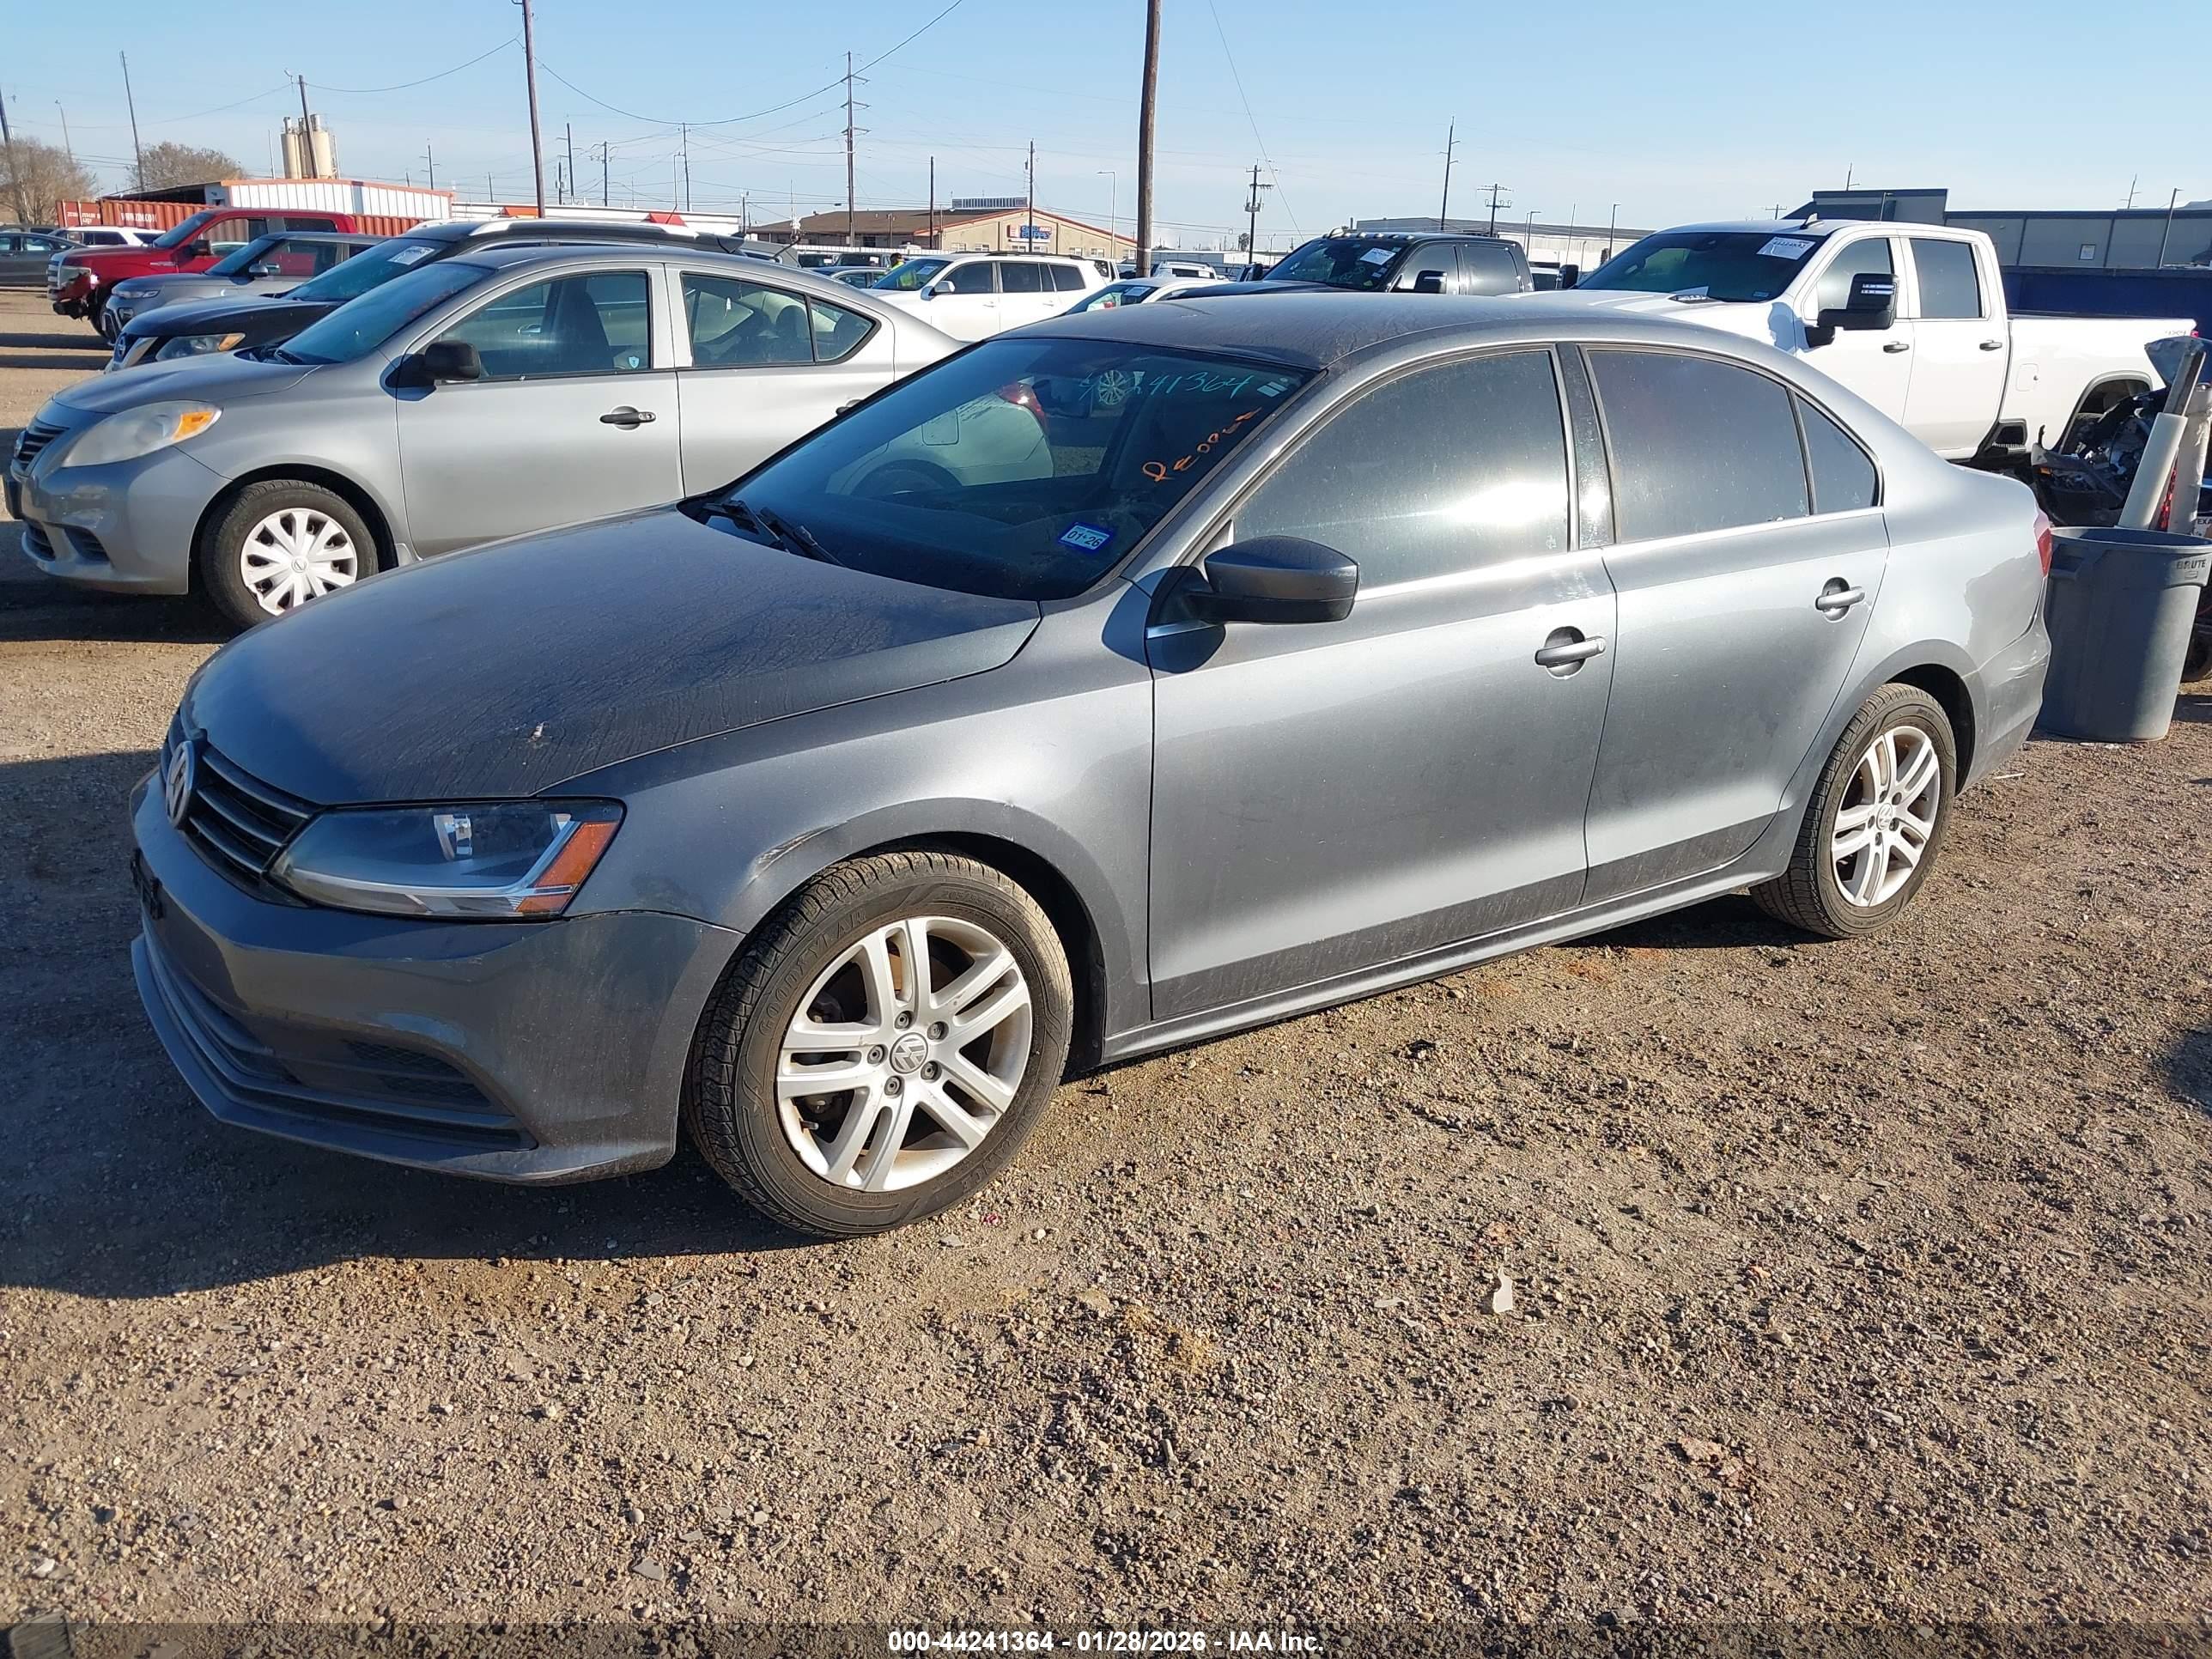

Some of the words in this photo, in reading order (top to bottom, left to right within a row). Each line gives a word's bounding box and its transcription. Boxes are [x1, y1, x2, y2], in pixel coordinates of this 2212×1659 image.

[1067, 531, 1083, 541] 01
[1085, 537, 1103, 547] 26
[2176, 559, 2207, 570] BRUTE
